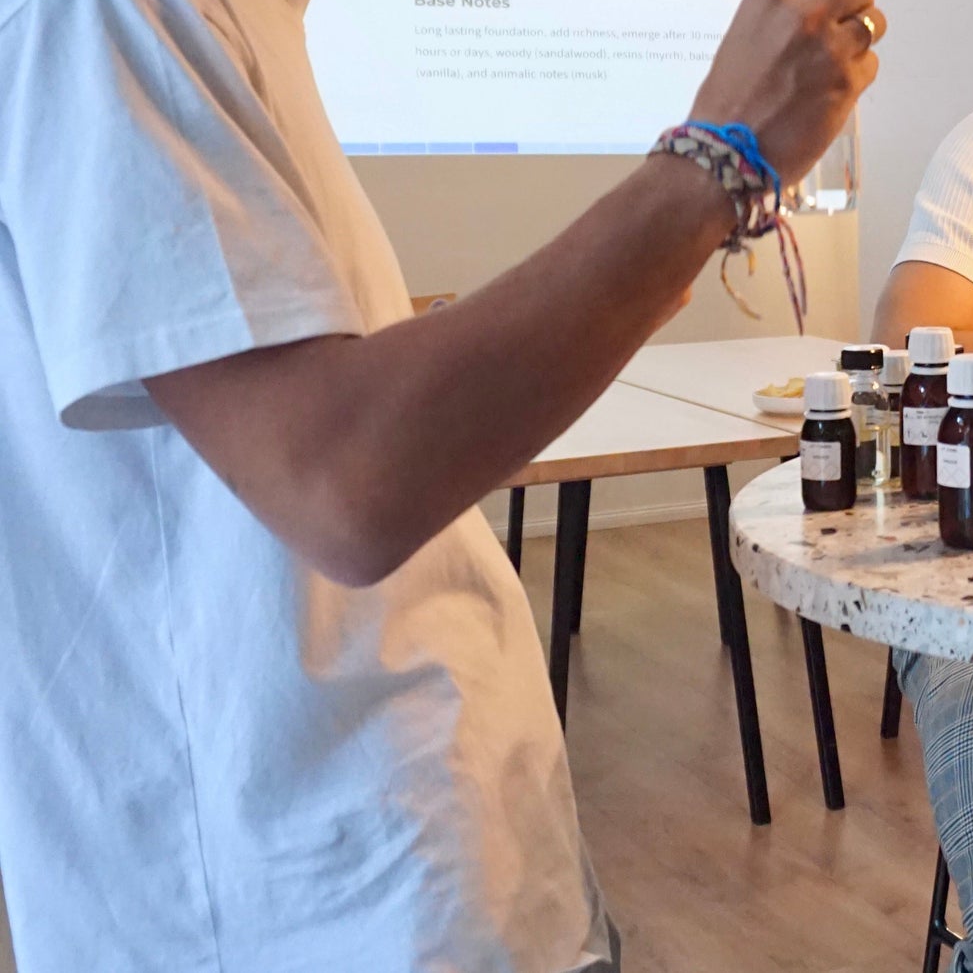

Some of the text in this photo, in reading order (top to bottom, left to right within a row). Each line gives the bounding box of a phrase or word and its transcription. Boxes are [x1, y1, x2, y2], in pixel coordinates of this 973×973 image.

[483, 25, 547, 38] foundation,
[550, 26, 570, 38] add
[573, 27, 619, 40] richness,
[621, 29, 660, 41] emerge
[663, 28, 687, 40] after
[415, 46, 448, 57] hours
[449, 49, 461, 57] or
[464, 46, 493, 59] days,
[495, 47, 532, 60] woody
[612, 50, 643, 60] resins
[415, 67, 464, 80] (vanilla),
[466, 67, 488, 79] and
[490, 68, 536, 80] animalic
[539, 69, 569, 80] notes
